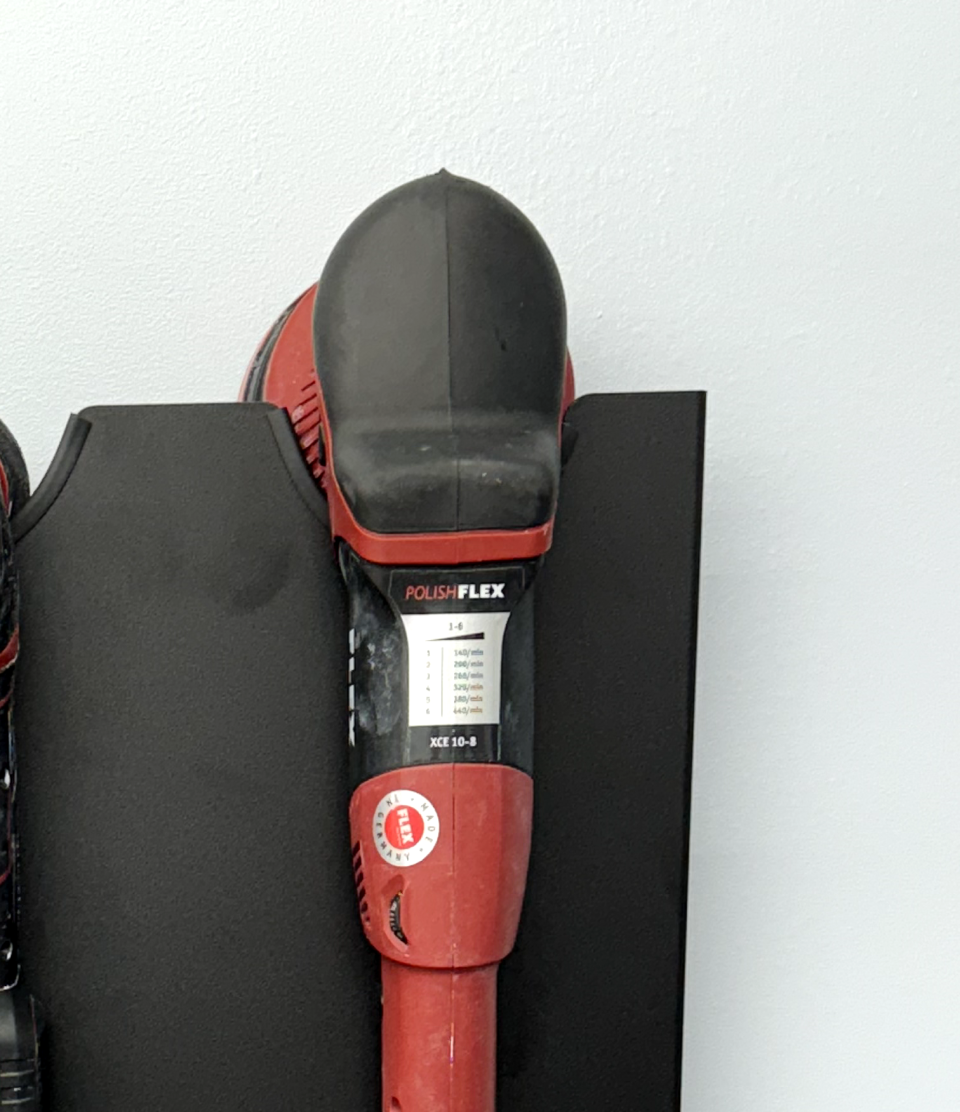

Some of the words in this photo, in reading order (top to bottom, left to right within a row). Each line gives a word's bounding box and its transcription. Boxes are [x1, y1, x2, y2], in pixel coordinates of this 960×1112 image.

[429, 737, 449, 748] XCE
[451, 737, 477, 748] 10-8
[396, 808, 414, 845] FLEX
